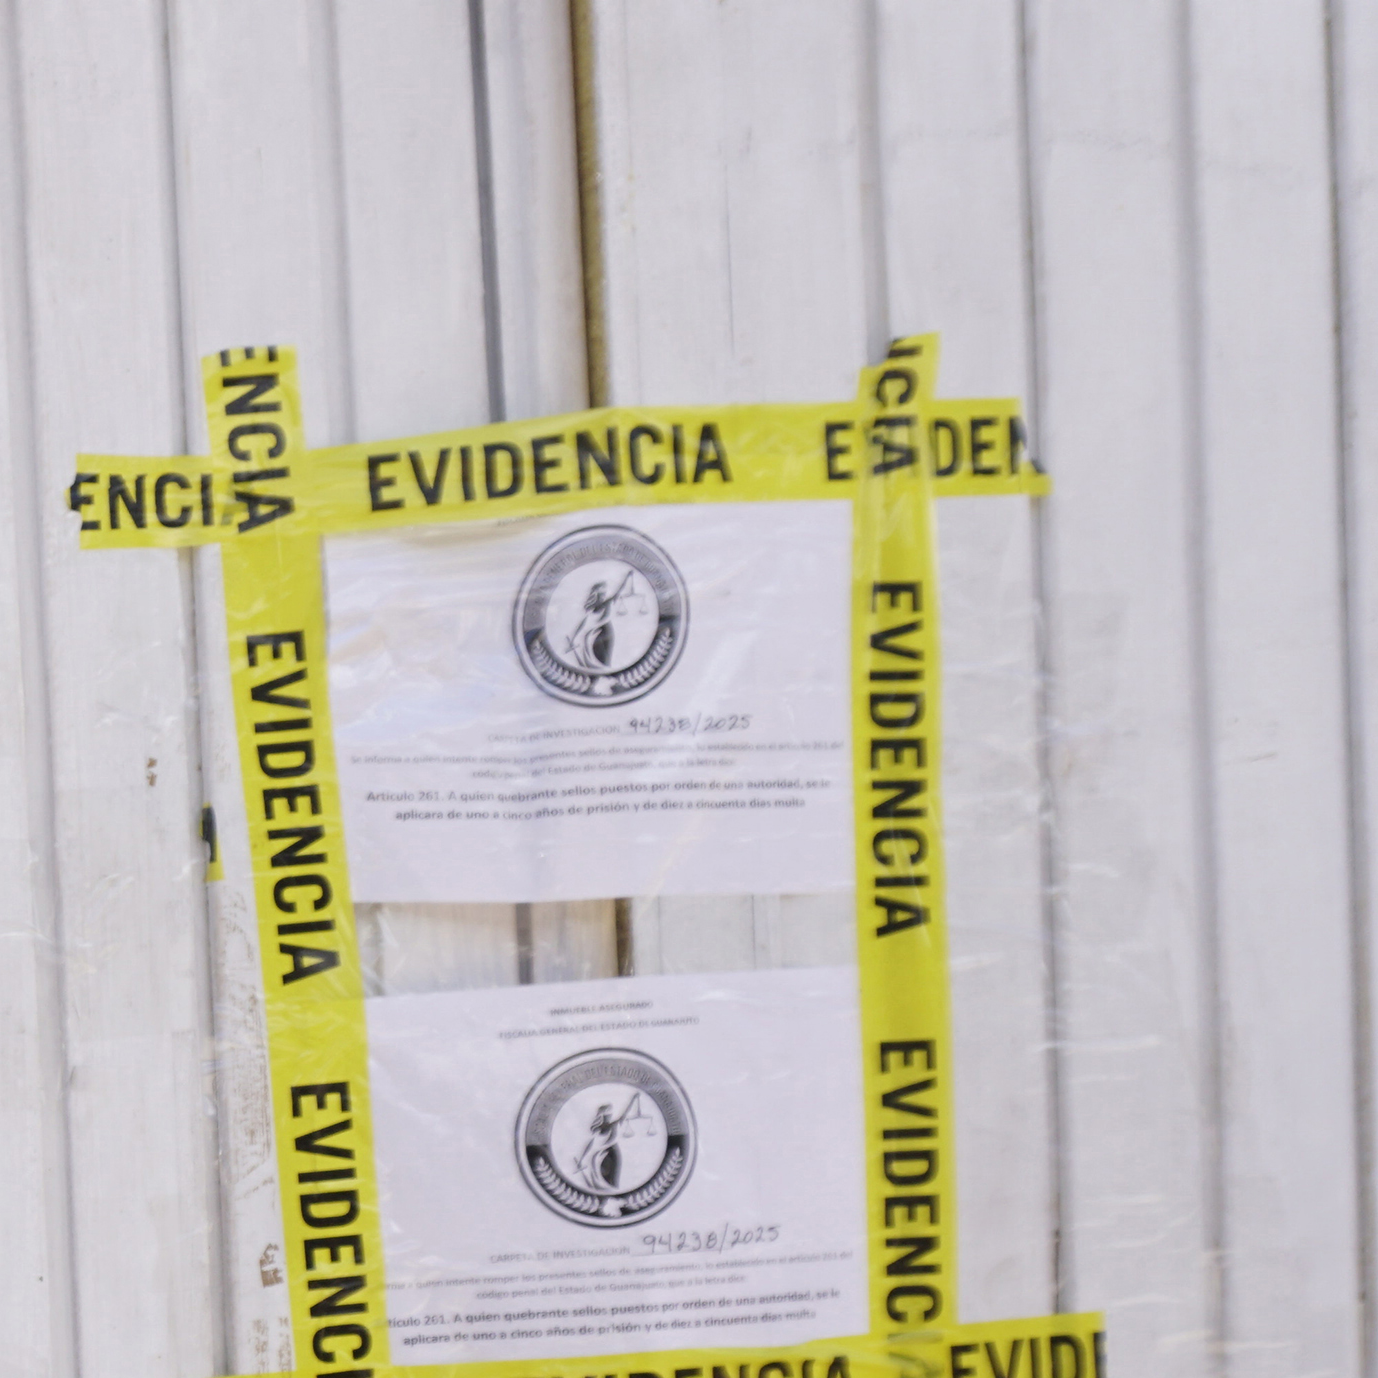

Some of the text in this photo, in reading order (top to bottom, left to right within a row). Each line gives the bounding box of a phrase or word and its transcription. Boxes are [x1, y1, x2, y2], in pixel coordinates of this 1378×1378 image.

[368, 421, 731, 511] EVIDENCIA
[70, 472, 216, 530] ENCI
[629, 712, 753, 736] 94238/2025
[870, 579, 932, 938] EVIDENCIA
[246, 629, 342, 986] EVIDENCIA
[460, 791, 494, 803] quien
[497, 788, 557, 803] quebrante
[561, 786, 597, 798] sellos
[600, 782, 647, 795] puestos
[651, 782, 670, 793] por
[674, 780, 706, 790] orden
[709, 779, 721, 789] de
[724, 780, 743, 789] una
[447, 809, 462, 819] de
[466, 810, 489, 819] uno
[502, 809, 532, 820] cinco
[536, 806, 565, 818] años
[567, 805, 583, 815] de
[586, 799, 630, 815] prisión
[643, 799, 657, 810] de
[661, 798, 684, 810] diez
[696, 798, 746, 809] cincuenta
[642, 1222, 782, 1255] 94238/2025
[388, 1316, 421, 1329] tículo
[454, 1313, 462, 1323] A
[466, 1311, 501, 1326] quien
[504, 1307, 569, 1323] quebrante
[572, 1305, 607, 1317] sellos
[611, 1303, 659, 1319] puestos
[661, 1301, 680, 1315] por
[682, 1298, 715, 1310] orden
[718, 1296, 732, 1307] de
[735, 1296, 756, 1307] una
[817, 1291, 829, 1301] se
[454, 1331, 469, 1342] de
[472, 1331, 497, 1342] uno
[511, 1328, 543, 1340] cinco
[546, 1326, 576, 1338] años
[579, 1324, 595, 1336] de
[598, 1322, 641, 1338] prisión
[655, 1320, 668, 1331] de
[670, 1317, 692, 1329] diez
[704, 1314, 758, 1328] cincuenta
